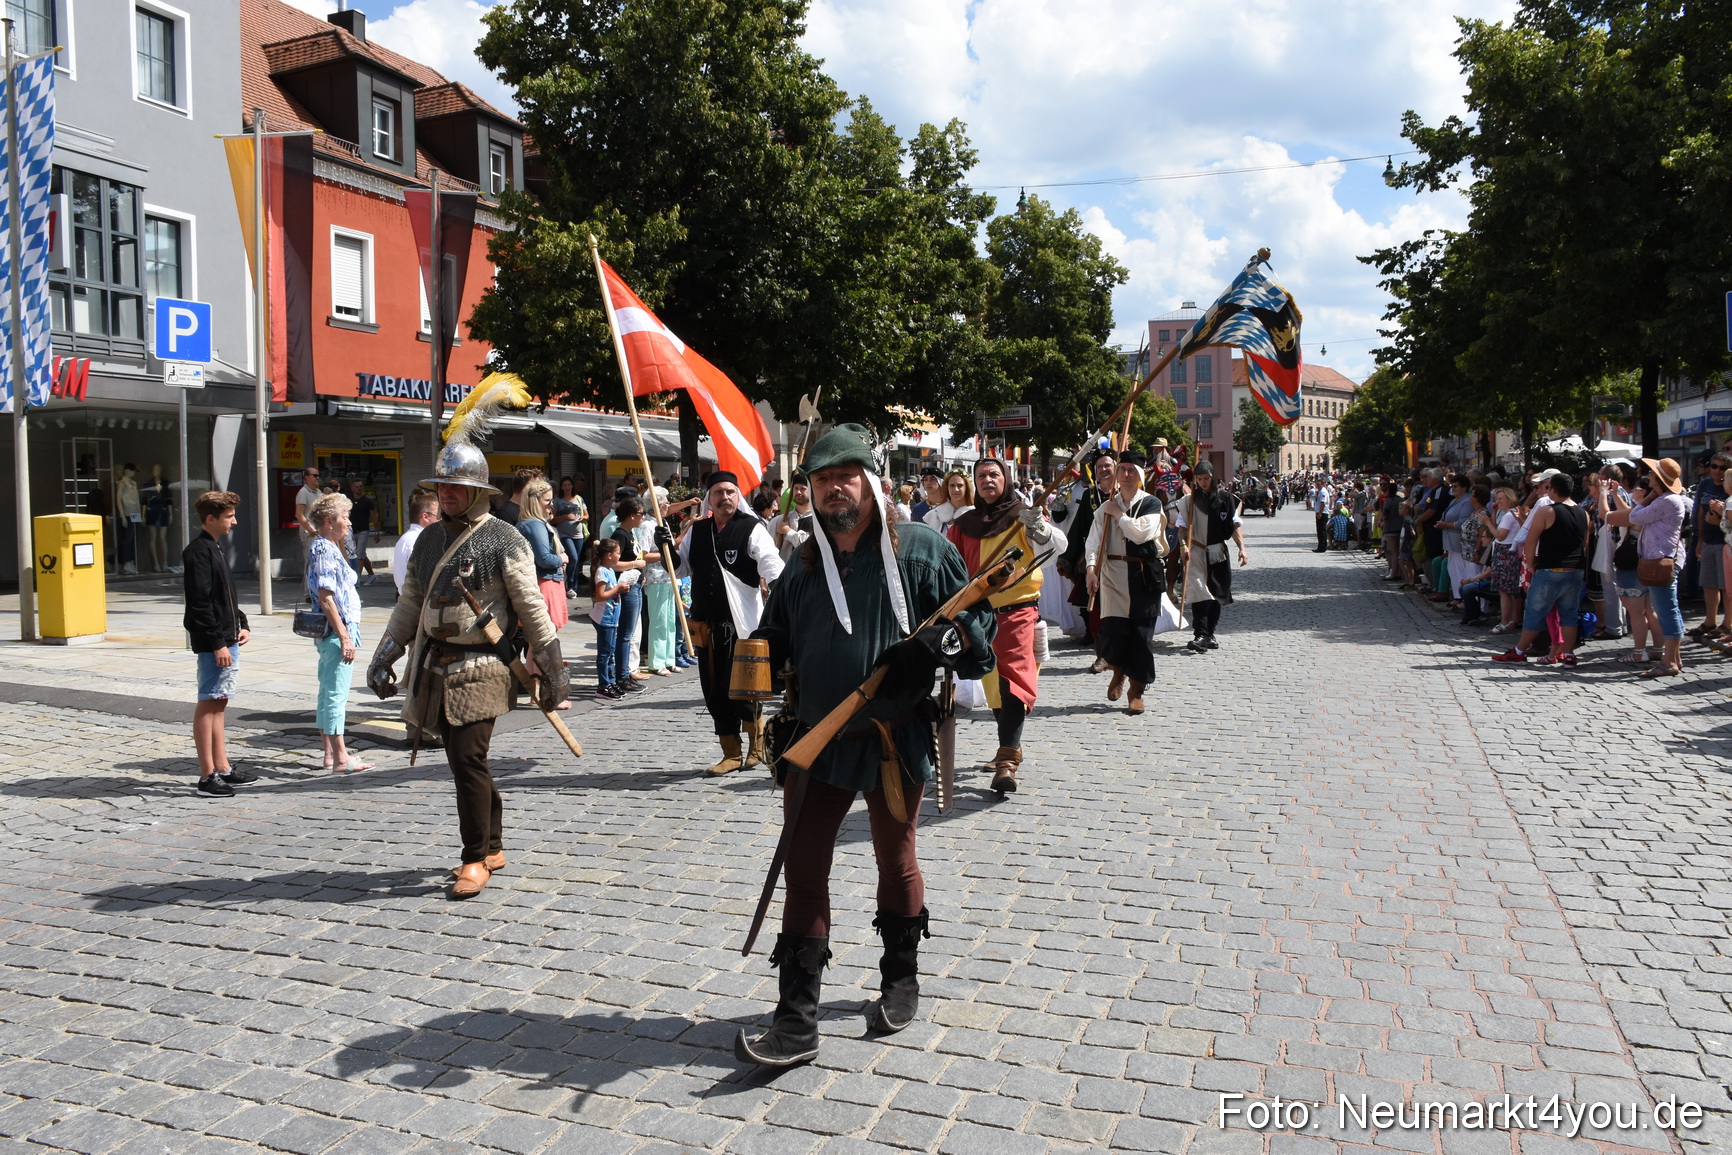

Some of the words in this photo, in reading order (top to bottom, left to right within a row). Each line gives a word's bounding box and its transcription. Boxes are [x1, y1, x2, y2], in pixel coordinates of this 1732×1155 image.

[168, 306, 199, 353] P
[362, 439, 377, 448] NZ
[281, 450, 302, 460] LOTTO
